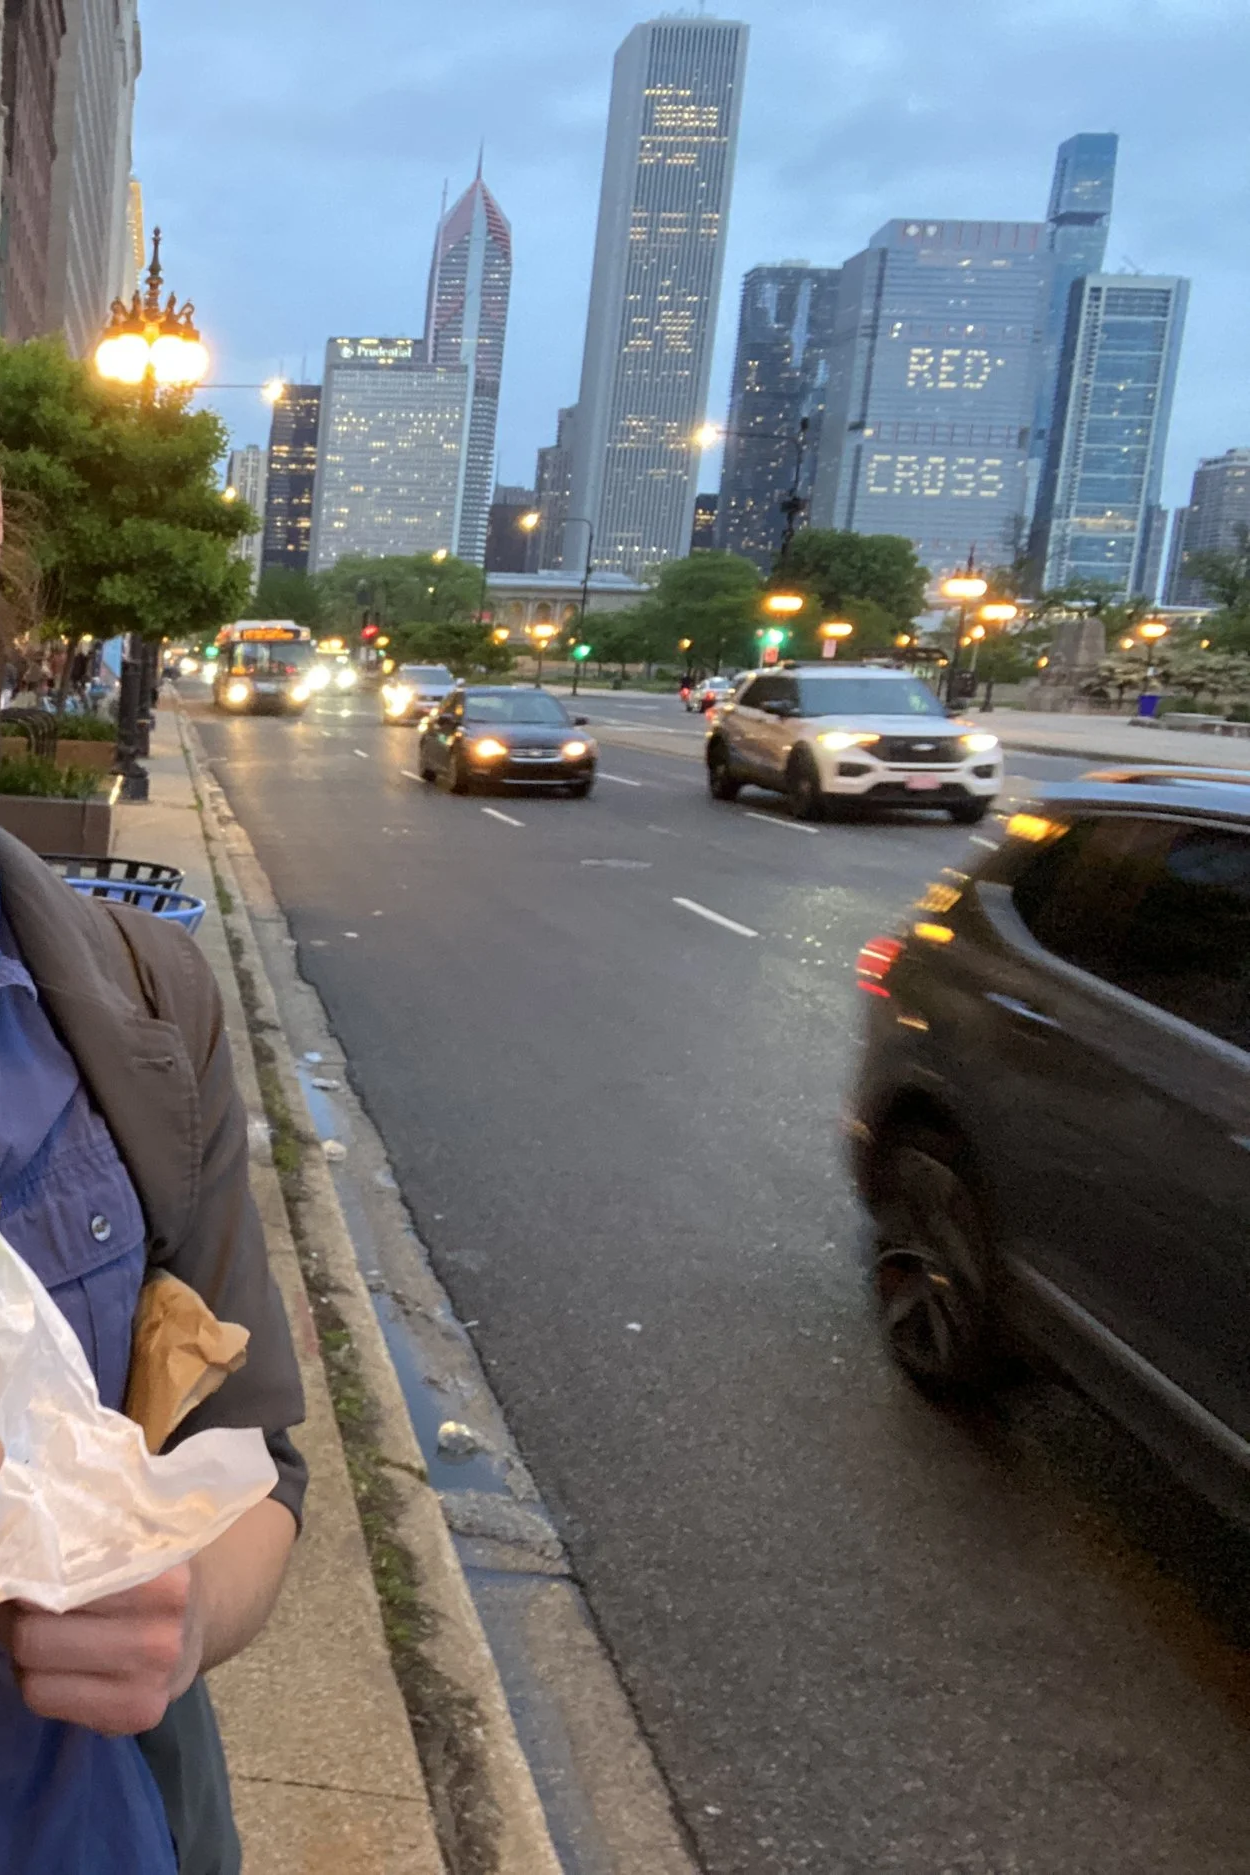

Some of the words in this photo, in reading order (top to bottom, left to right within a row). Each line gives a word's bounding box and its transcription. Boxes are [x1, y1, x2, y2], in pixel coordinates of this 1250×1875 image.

[357, 345, 412, 358] Prudential
[907, 349, 991, 388] RED
[867, 455, 1003, 496] CROSS
